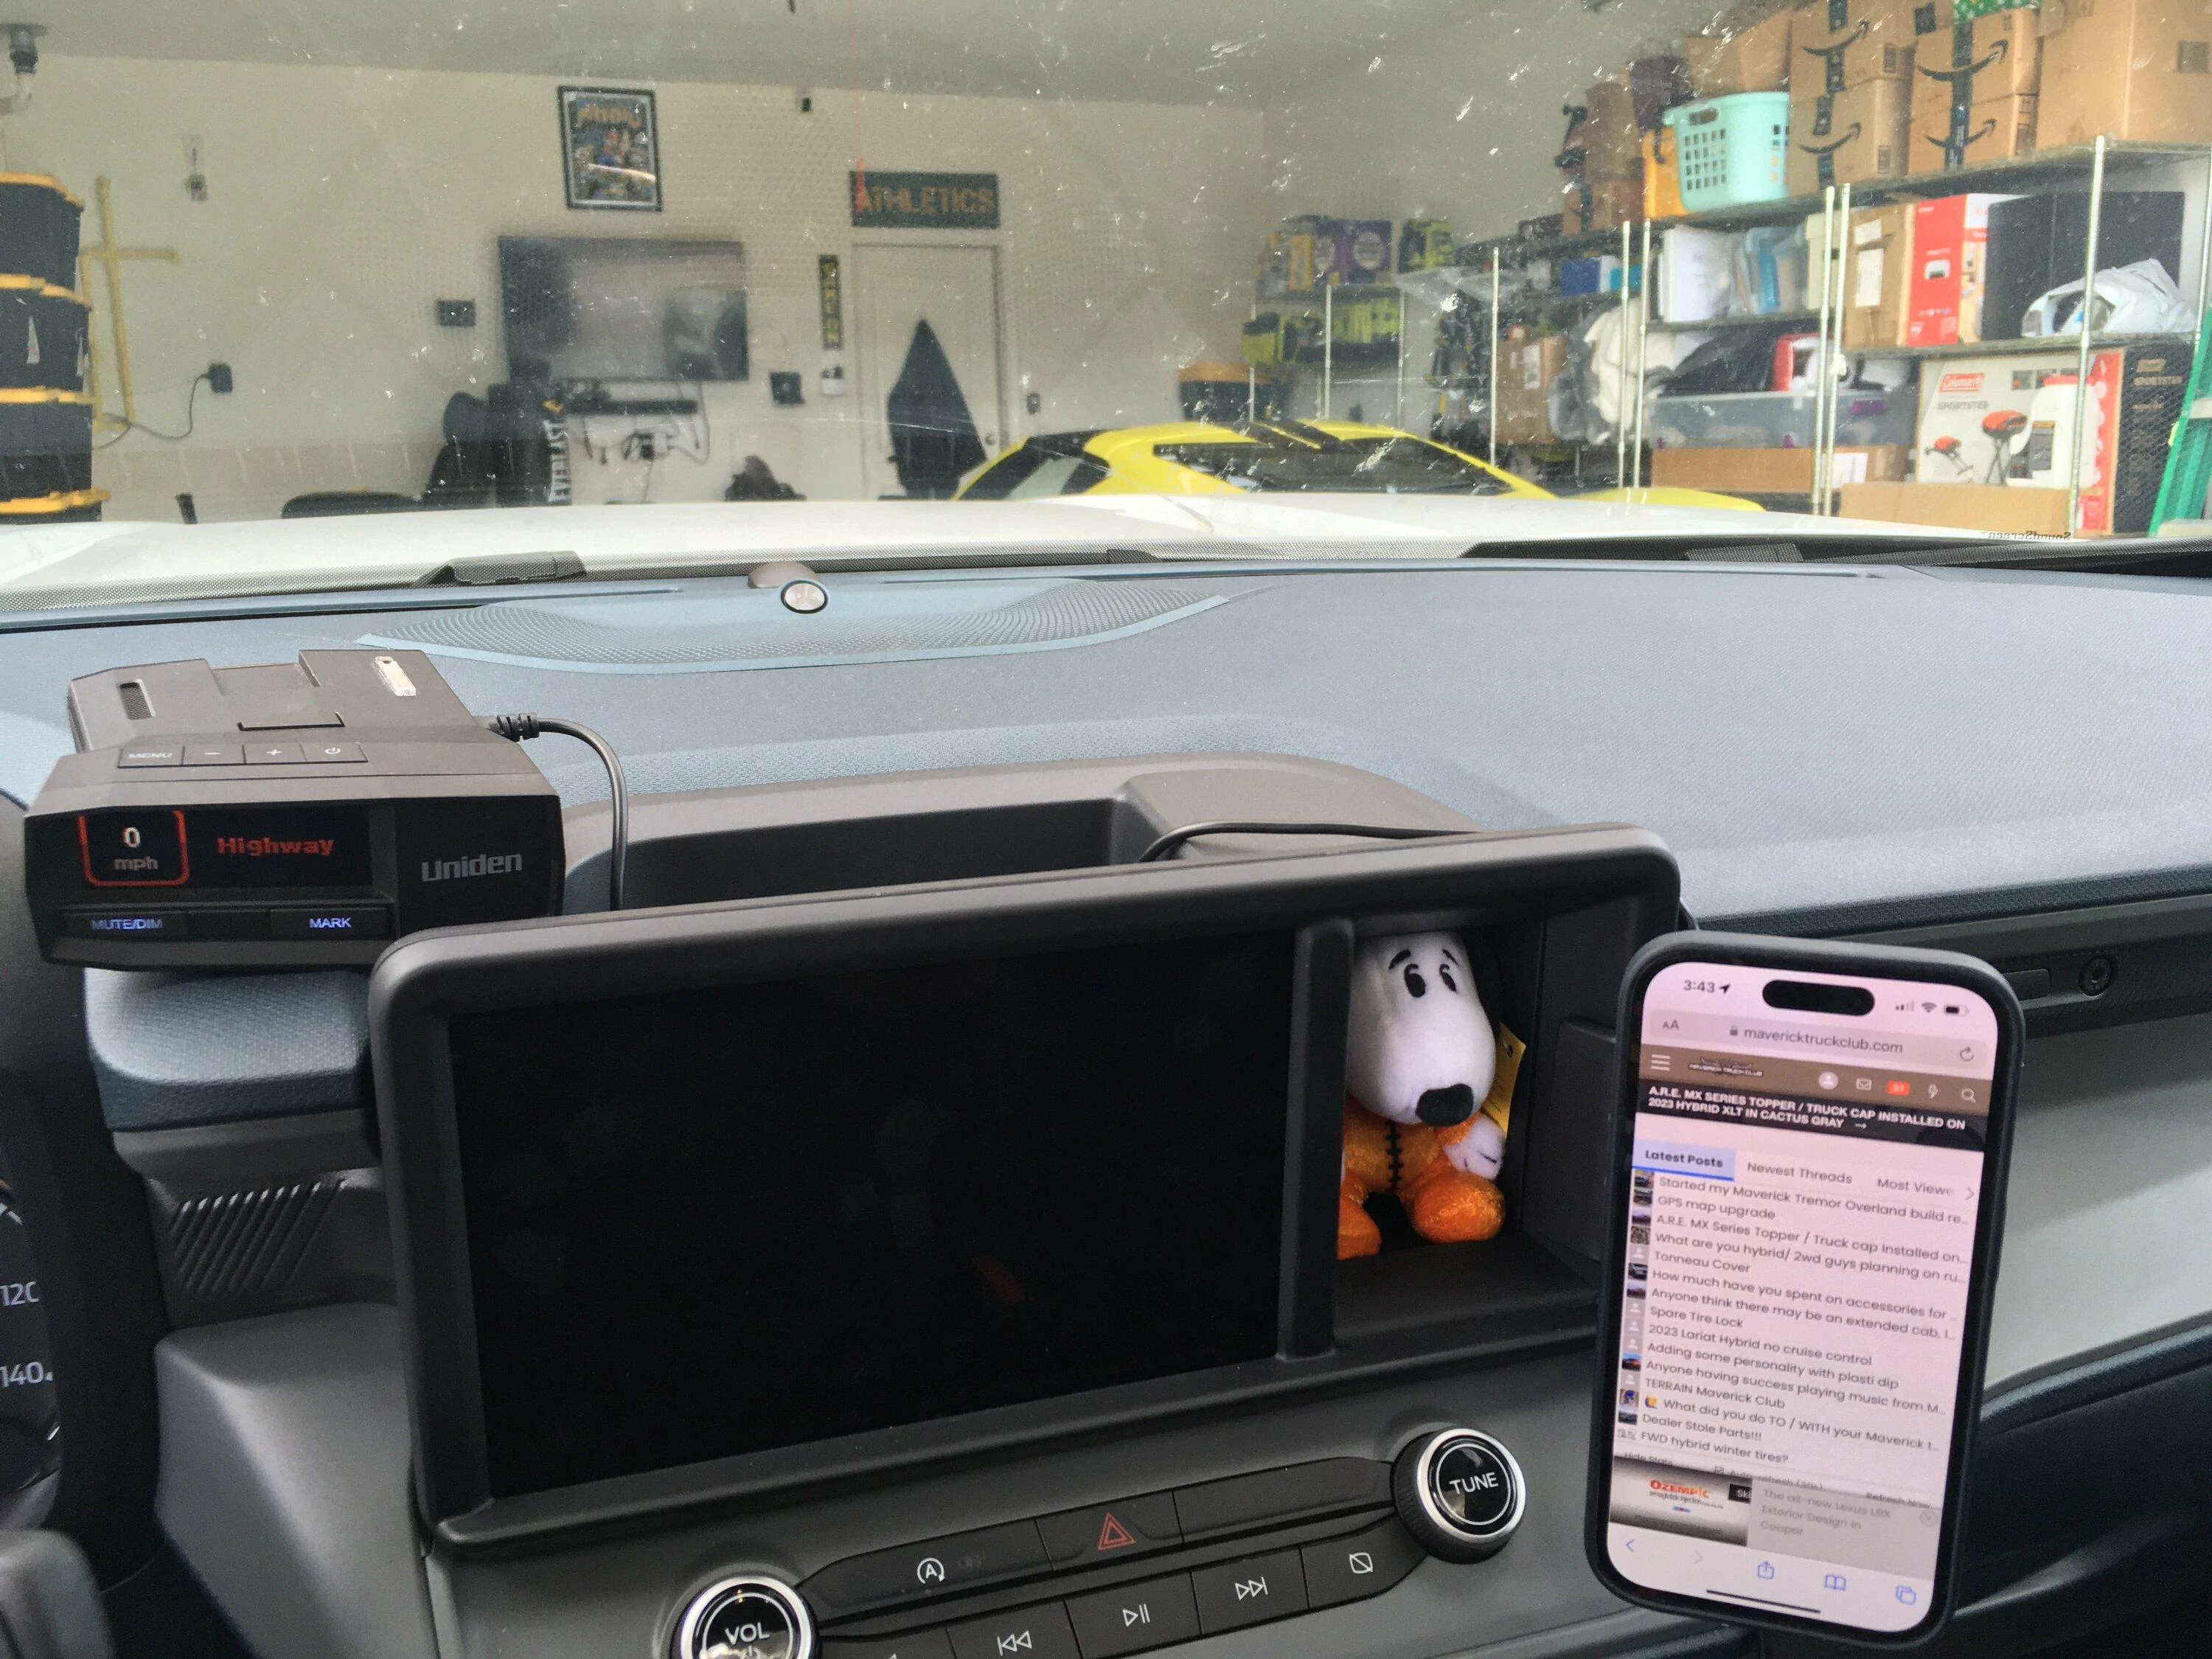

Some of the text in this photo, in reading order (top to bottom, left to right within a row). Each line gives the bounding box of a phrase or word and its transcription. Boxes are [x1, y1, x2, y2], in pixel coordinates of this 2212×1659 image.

[123, 827, 141, 848] 0
[217, 837, 334, 857] Highway
[113, 856, 158, 872] mph
[422, 852, 523, 883] Uniden
[91, 917, 163, 931] MUTE/DIM
[309, 917, 351, 930] MARK
[1683, 979, 1715, 993] 3:43
[1744, 1026, 1903, 1053] mavericktruckclub.com
[1648, 1097, 1843, 1127] 2023 HYBRID XLT IN CACTUS GRAY
[1649, 1085, 1681, 1098] A.R.E.
[1684, 1089, 1703, 1100] MX
[1704, 1091, 1746, 1105] SERIES
[1748, 1096, 1795, 1110] TOPPER
[1806, 1102, 1848, 1116] TRUCK
[1849, 1107, 1875, 1119] CAP
[1877, 1110, 1944, 1126] INSTALLED
[1947, 1118, 1965, 1129] ON
[1645, 1150, 1723, 1168] Latest Posts
[1747, 1161, 1852, 1183] Newest Threads
[1877, 1177, 1909, 1191] Most
[1657, 1195, 1775, 1220] GPS map upgrade
[1659, 1176, 1706, 1192] Started
[1708, 1183, 1731, 1197] my
[1732, 1185, 1791, 1203] Maverick
[1795, 1193, 1842, 1209] Tremor
[1844, 1199, 1907, 1217] Overland
[1909, 1207, 1944, 1222] build
[1655, 1214, 1687, 1227] A.R.E.
[1690, 1217, 1709, 1230] MX
[1712, 1220, 1750, 1236] Series
[1754, 1226, 1801, 1242] Topper
[1813, 1234, 1848, 1248] Truck
[1851, 1241, 1878, 1254] cap
[1654, 1250, 1750, 1273] Tonneau Cover
[1655, 1232, 1688, 1246] What
[1691, 1238, 1714, 1249] are
[1716, 1242, 1740, 1253] you
[1742, 1243, 1791, 1262] hybrid/
[1793, 1250, 1821, 1264] 2wd
[1823, 1256, 1857, 1270] guys
[1858, 1260, 1919, 1280] planning
[1921, 1269, 1940, 1280] on
[1652, 1269, 1947, 1319] How much have you spent on accessories for
[1649, 1305, 1743, 1328] Spare Tire Lock
[1650, 1287, 1699, 1304] Anyone
[1701, 1294, 1732, 1307] think
[1735, 1299, 1770, 1313] there
[1772, 1306, 1802, 1321] may
[1804, 1308, 1823, 1321] be
[1824, 1313, 1843, 1324] an
[1845, 1315, 1909, 1334] extended
[1910, 1326, 1941, 1339] cab,
[1648, 1323, 1872, 1366] 2023 Lariat Hybrid no cruise control
[1646, 1342, 1899, 1391] Adding some personality with plasti dip
[1645, 1360, 1693, 1376] Anyone
[1694, 1366, 1739, 1385] having
[1742, 1376, 1794, 1392] success
[1796, 1383, 1846, 1402] playing
[1848, 1391, 1889, 1406] music
[1891, 1397, 1924, 1411] from
[1645, 1377, 1785, 1409] TERRAIN Maverick Club
[1642, 1413, 1761, 1441] Dealer Stole Parts!!!
[1663, 1398, 1696, 1413] What
[1698, 1405, 1719, 1416] did
[1722, 1409, 1746, 1421] you
[1748, 1412, 1766, 1424] do
[1768, 1415, 1787, 1427] TO
[1798, 1420, 1830, 1434] WITH
[1833, 1427, 1863, 1439] your
[1865, 1430, 1924, 1449] Maverick
[1641, 1430, 1789, 1463] FWD hybrid winter tires?
[1449, 1472, 1499, 1495] TUNE
[1764, 1489, 1784, 1500] The
[1835, 1501, 1868, 1514] Lexus
[1762, 1505, 1802, 1520] Exterior
[1806, 1512, 1846, 1530] Design
[724, 1621, 771, 1645] VOL
